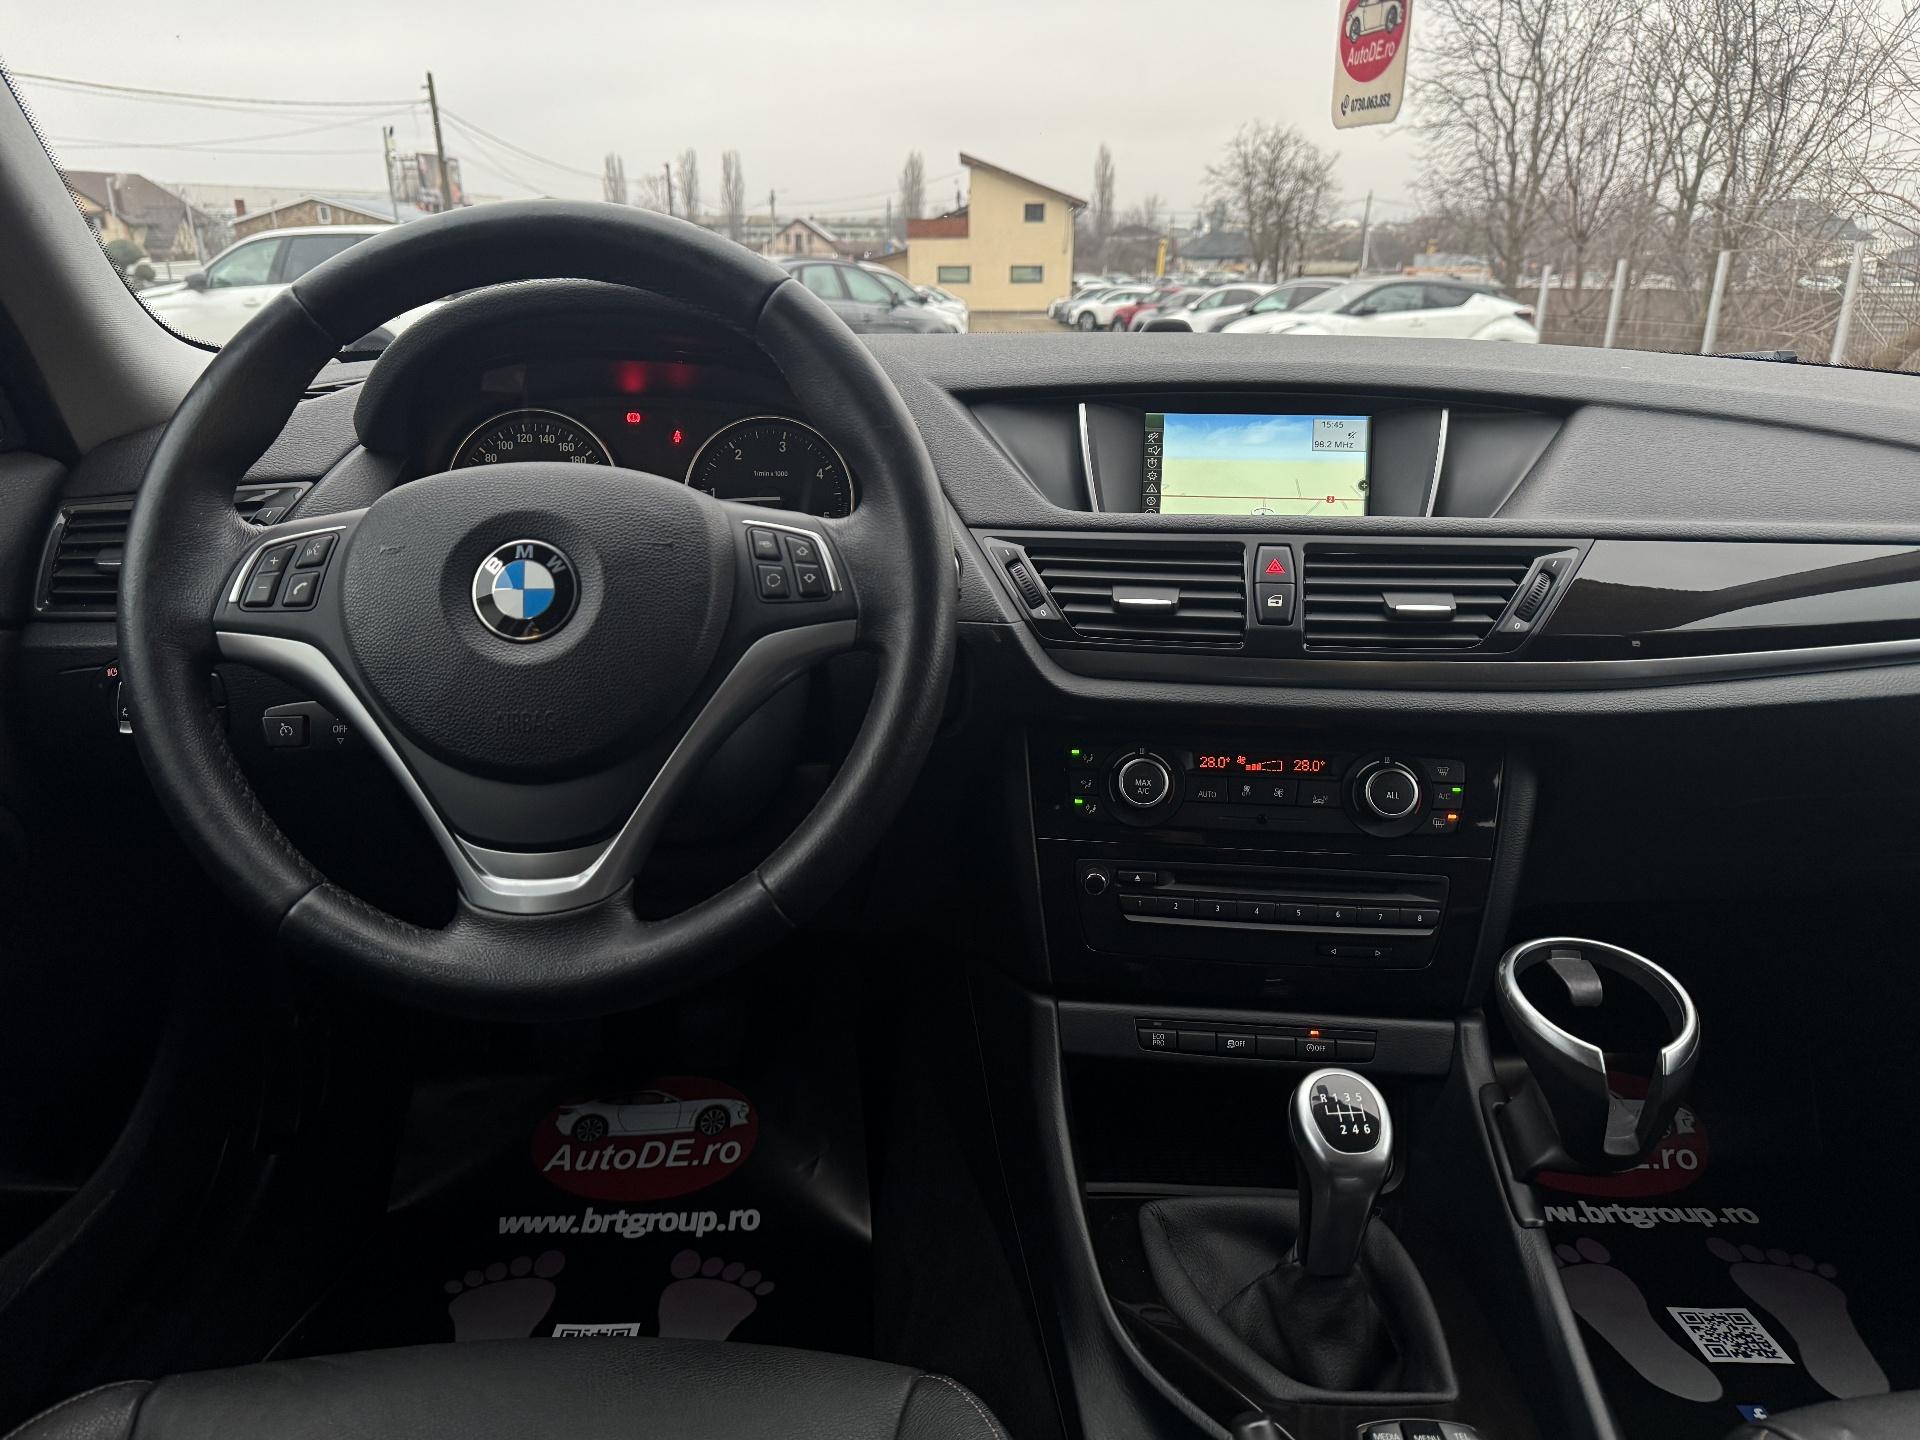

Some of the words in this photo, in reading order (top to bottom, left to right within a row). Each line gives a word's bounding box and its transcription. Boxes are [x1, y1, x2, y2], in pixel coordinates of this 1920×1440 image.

[1346, 39, 1395, 67] AutoDE.ro
[1322, 421, 1344, 429] 15:45
[517, 434, 533, 443] 120
[539, 434, 555, 444] 140
[497, 441, 513, 450] 100
[558, 443, 574, 452] 160
[779, 441, 787, 453] 3
[1334, 441, 1354, 449] MHz
[485, 453, 497, 462] 80
[570, 456, 587, 464] 180
[734, 449, 742, 461] 2
[816, 468, 824, 480] 4
[484, 545, 567, 576] BMW
[332, 724, 348, 734] OFF
[1135, 778, 1152, 787] MAX
[1137, 787, 1150, 795] A/C
[1198, 790, 1217, 798] AUTO
[1386, 791, 1400, 800] ALL
[1173, 902, 1178, 910] 2
[1254, 907, 1260, 915] 4
[1296, 909, 1301, 917] 5
[1378, 913, 1383, 921] 7
[1417, 914, 1422, 922] 8
[1234, 1040, 1246, 1048] OFF
[1314, 1044, 1326, 1052] OFF
[1320, 1093, 1327, 1102] R
[1332, 1093, 1337, 1102] 1
[1344, 1093, 1350, 1101] 3
[1355, 1093, 1362, 1101] 5
[1340, 1124, 1348, 1135] 2
[1352, 1124, 1360, 1134] 4
[1363, 1123, 1371, 1134] 6
[543, 1138, 741, 1172] AutoDE.ro
[499, 1207, 761, 1239] www.brtgroup.ro
